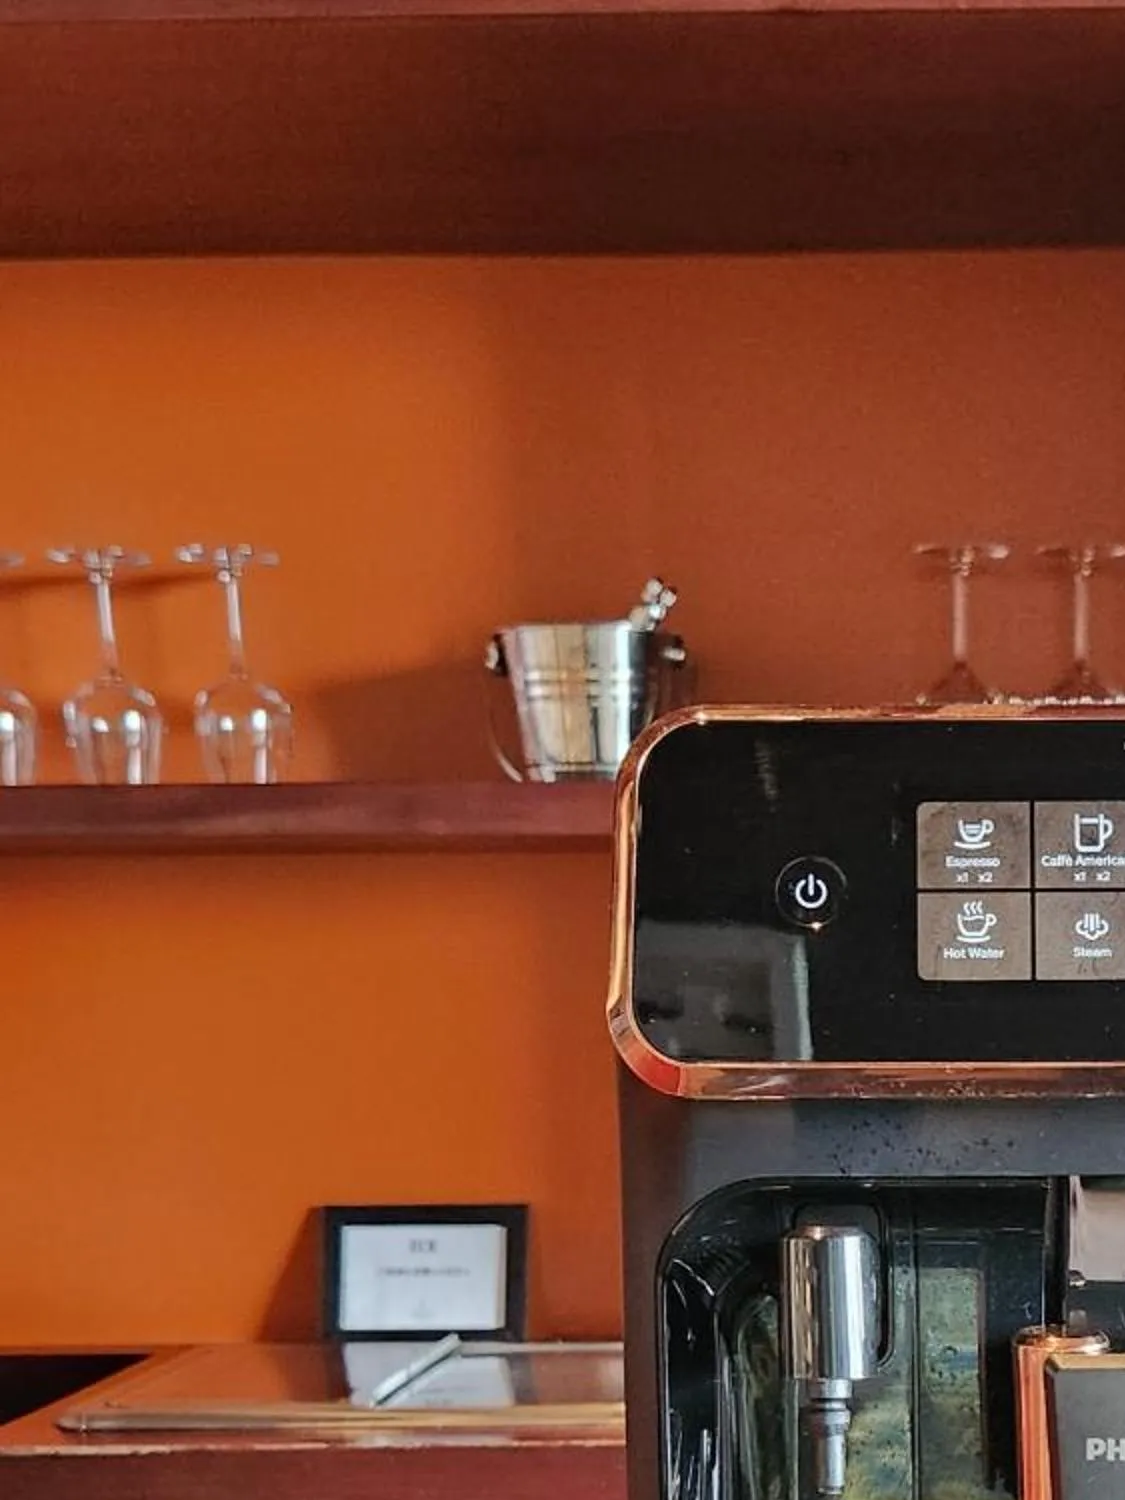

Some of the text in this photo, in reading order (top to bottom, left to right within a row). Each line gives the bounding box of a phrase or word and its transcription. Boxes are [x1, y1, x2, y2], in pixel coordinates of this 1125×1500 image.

[945, 855, 1001, 868] Espresso
[956, 871, 993, 883] x1 x2
[1073, 871, 1111, 882] x1 x2
[943, 947, 1005, 960] Hot Water
[1072, 946, 1113, 958] Steam
